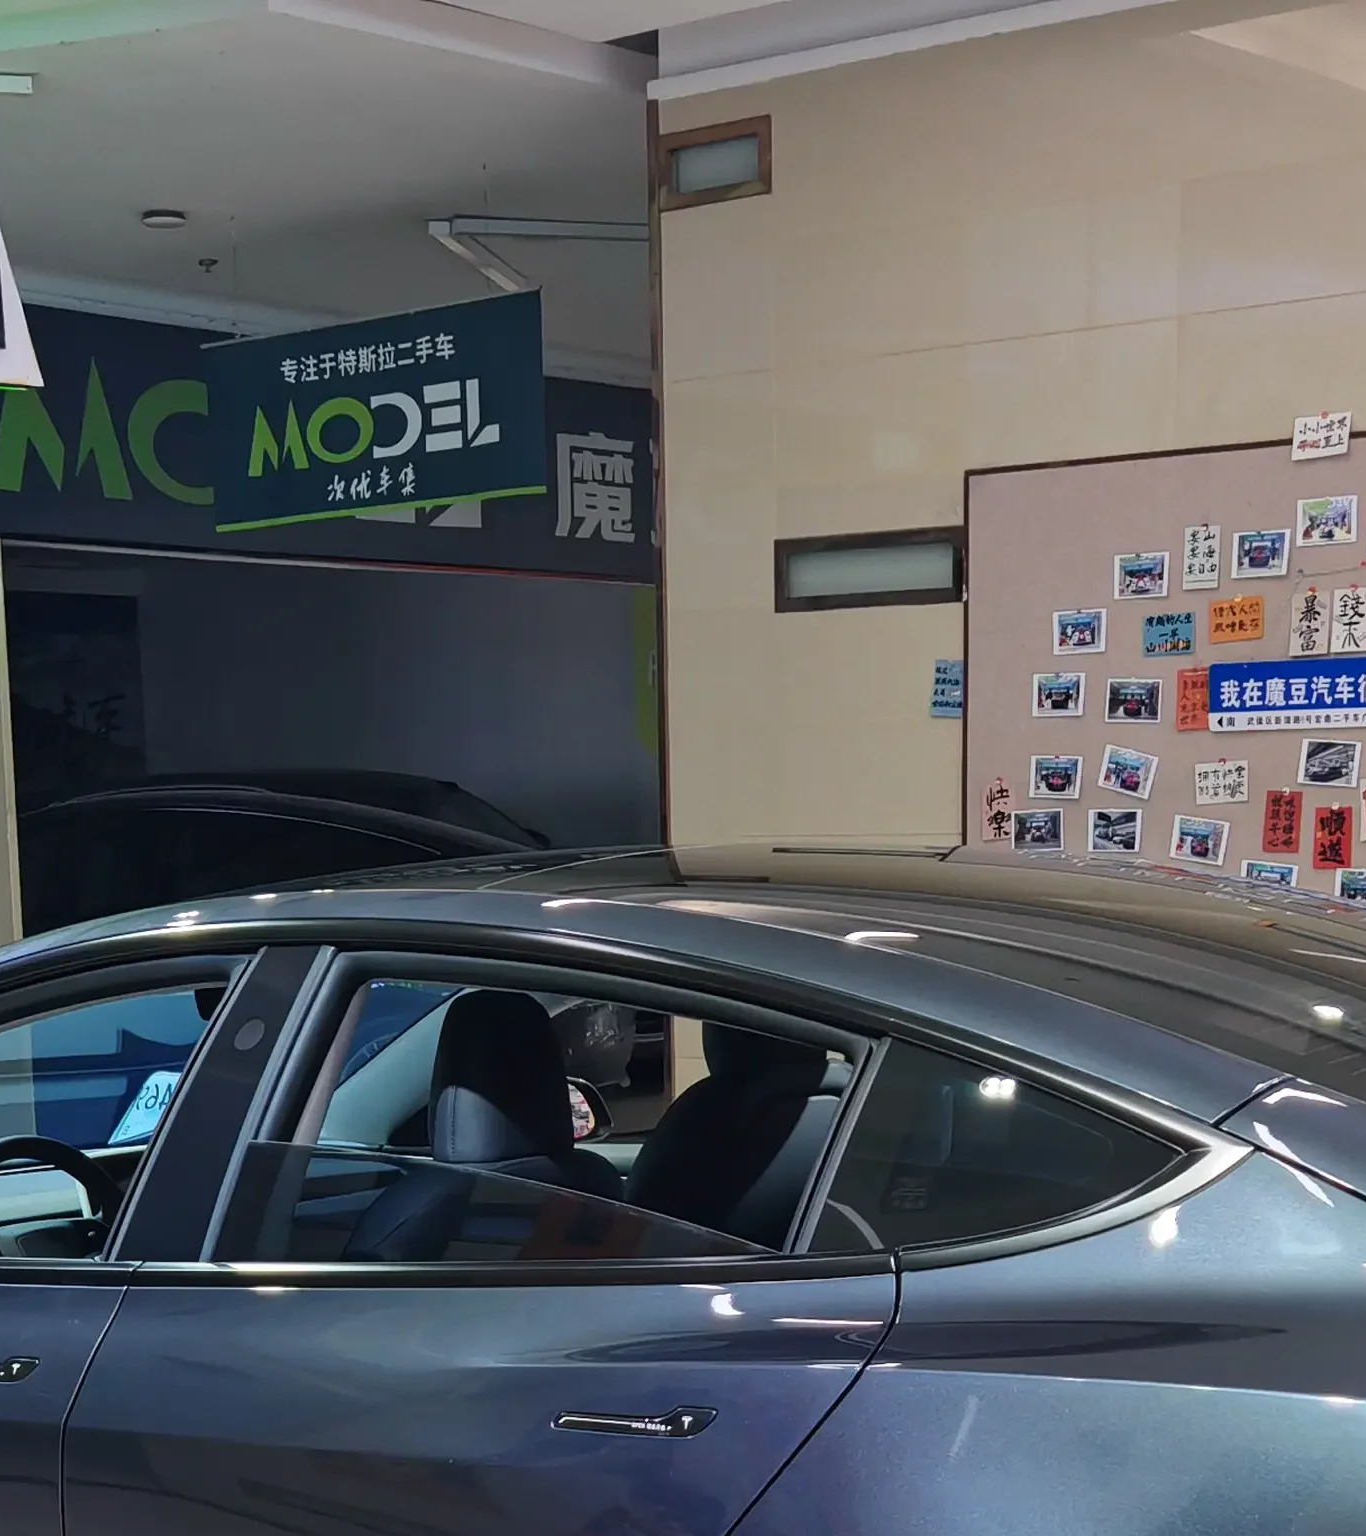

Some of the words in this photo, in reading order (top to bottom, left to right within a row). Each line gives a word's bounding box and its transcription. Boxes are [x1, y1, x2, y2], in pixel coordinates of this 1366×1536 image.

[280, 333, 456, 384] 专注于特斯拉二手车
[248, 377, 501, 478] MODEL
[556, 431, 658, 548] 魔
[1299, 595, 1321, 652] 暴富
